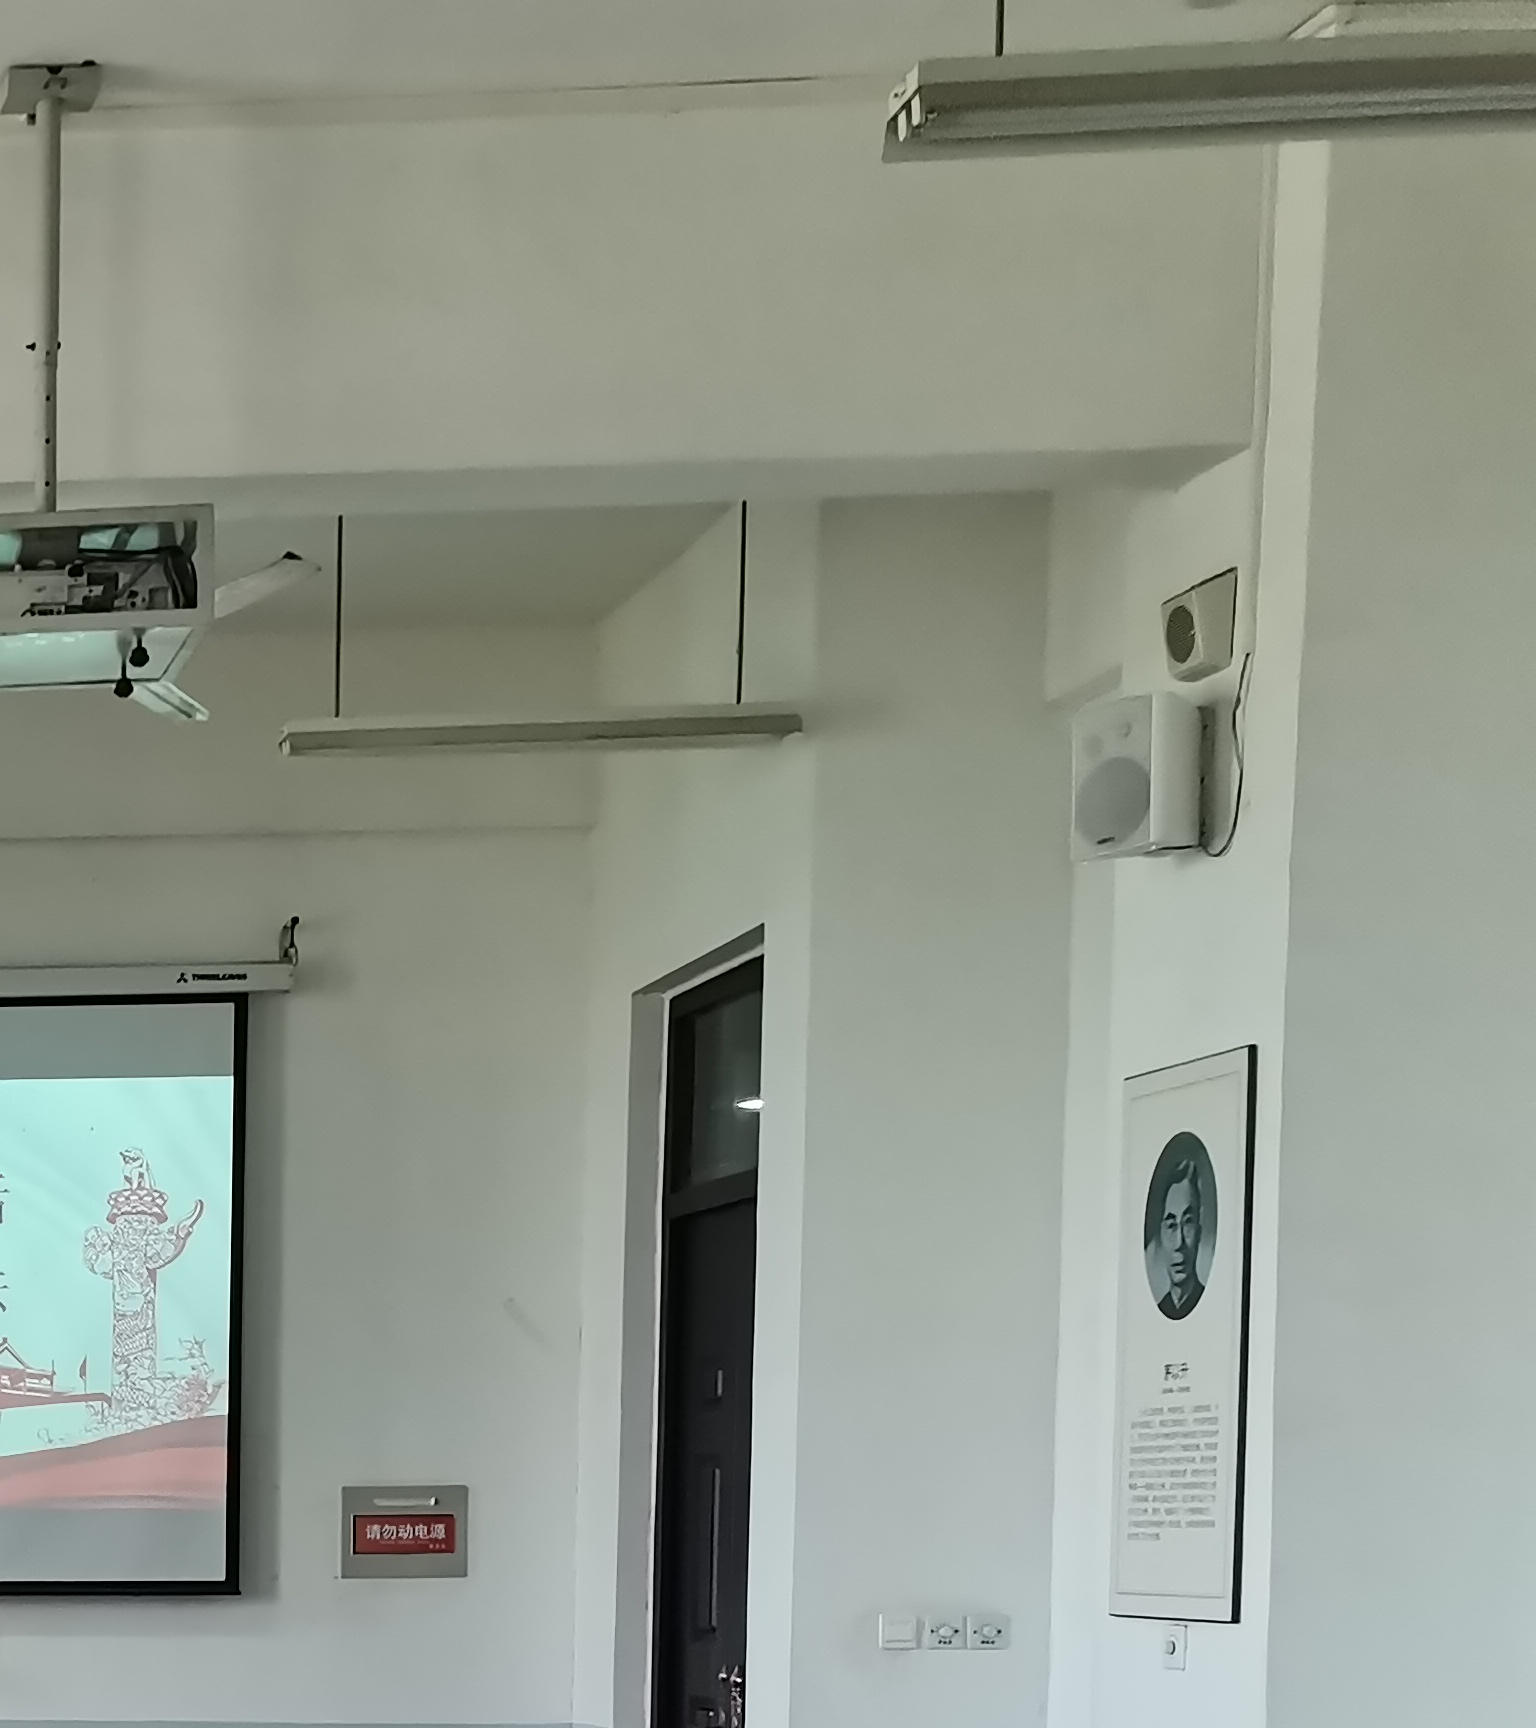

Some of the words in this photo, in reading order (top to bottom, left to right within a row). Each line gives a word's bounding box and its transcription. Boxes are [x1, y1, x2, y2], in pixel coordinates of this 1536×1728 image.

[365, 1523, 446, 1540] 请勿动电源
